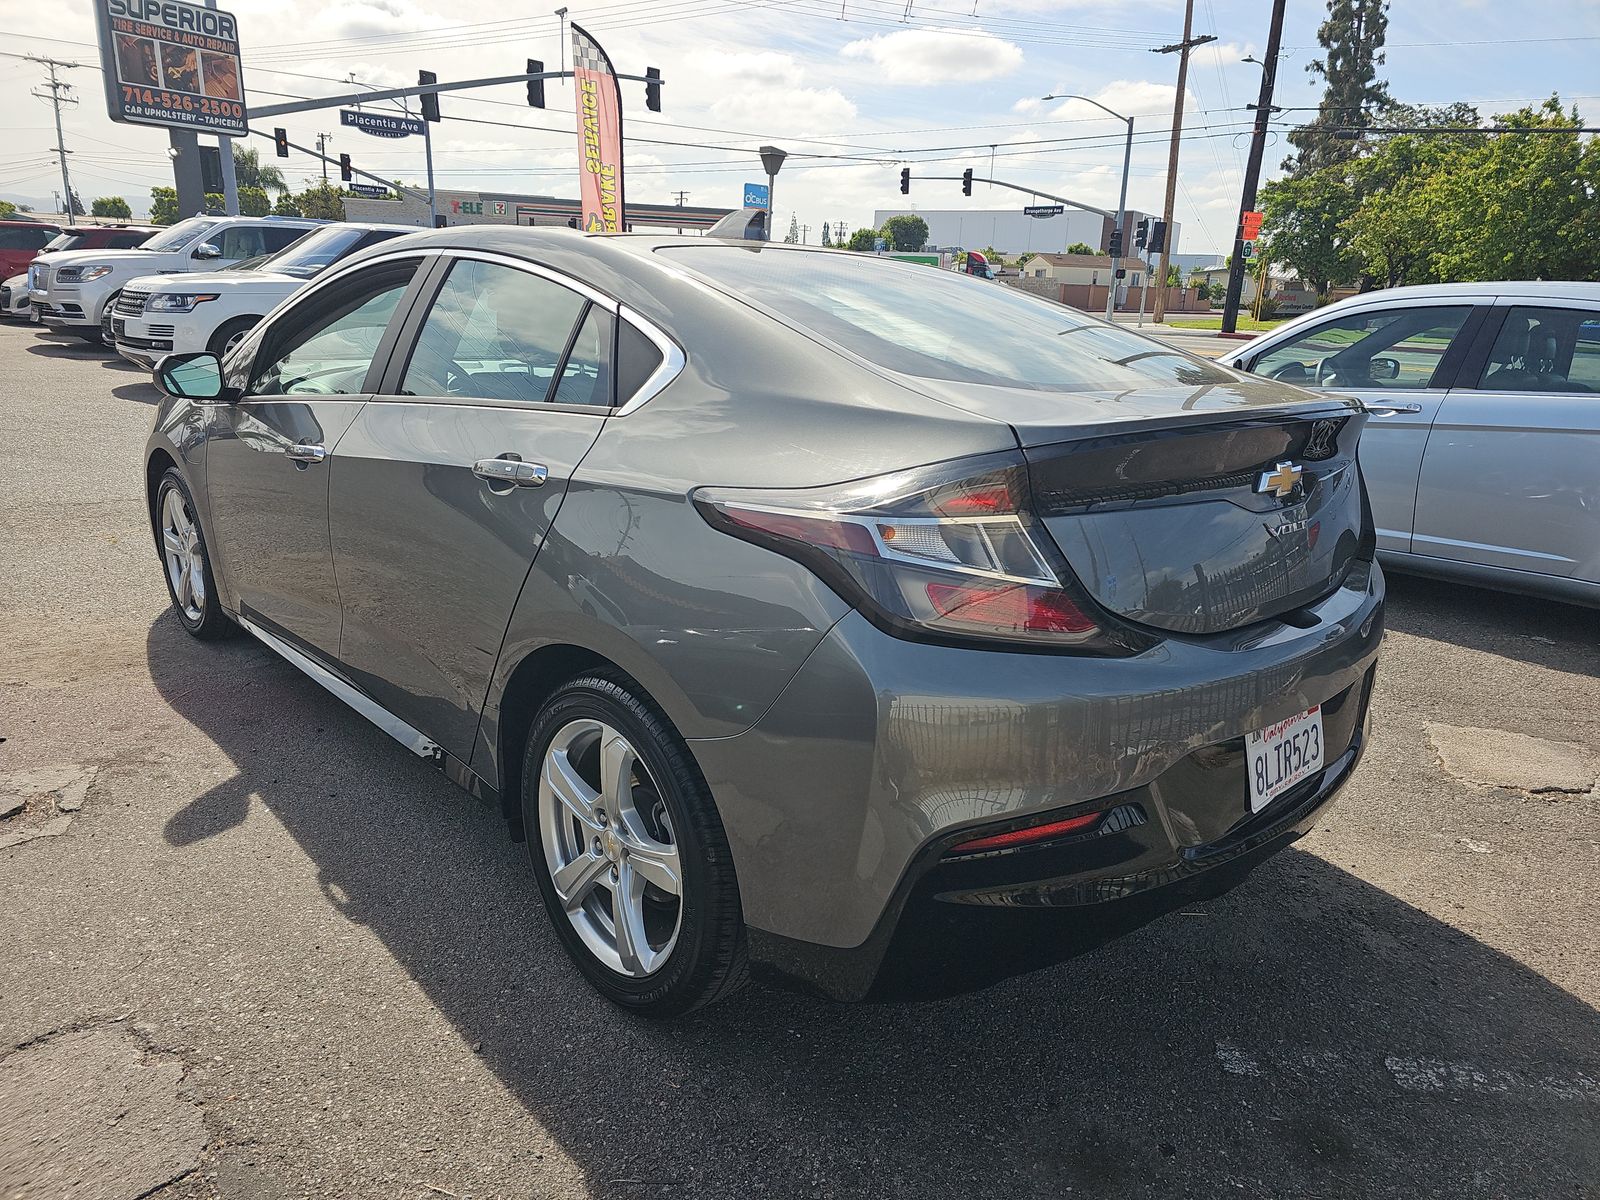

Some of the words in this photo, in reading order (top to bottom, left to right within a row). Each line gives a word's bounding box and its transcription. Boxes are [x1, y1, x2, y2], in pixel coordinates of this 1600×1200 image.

[110, 0, 234, 39] SUPERIOR
[112, 18, 133, 32] TIRE
[135, 24, 172, 41] SERVICE
[174, 32, 180, 42] &
[182, 34, 205, 47] AUTO
[206, 38, 235, 54] REPAIR
[122, 86, 242, 118] 714-526-2500
[124, 104, 142, 115] CAR
[144, 106, 197, 122] UPHOLSTERY
[347, 113, 397, 129] Placentia
[400, 121, 419, 132] Ave
[351, 184, 375, 193] Placentia
[1264, 519, 1308, 542] VOLT
[1255, 723, 1320, 796] 8LIR523
